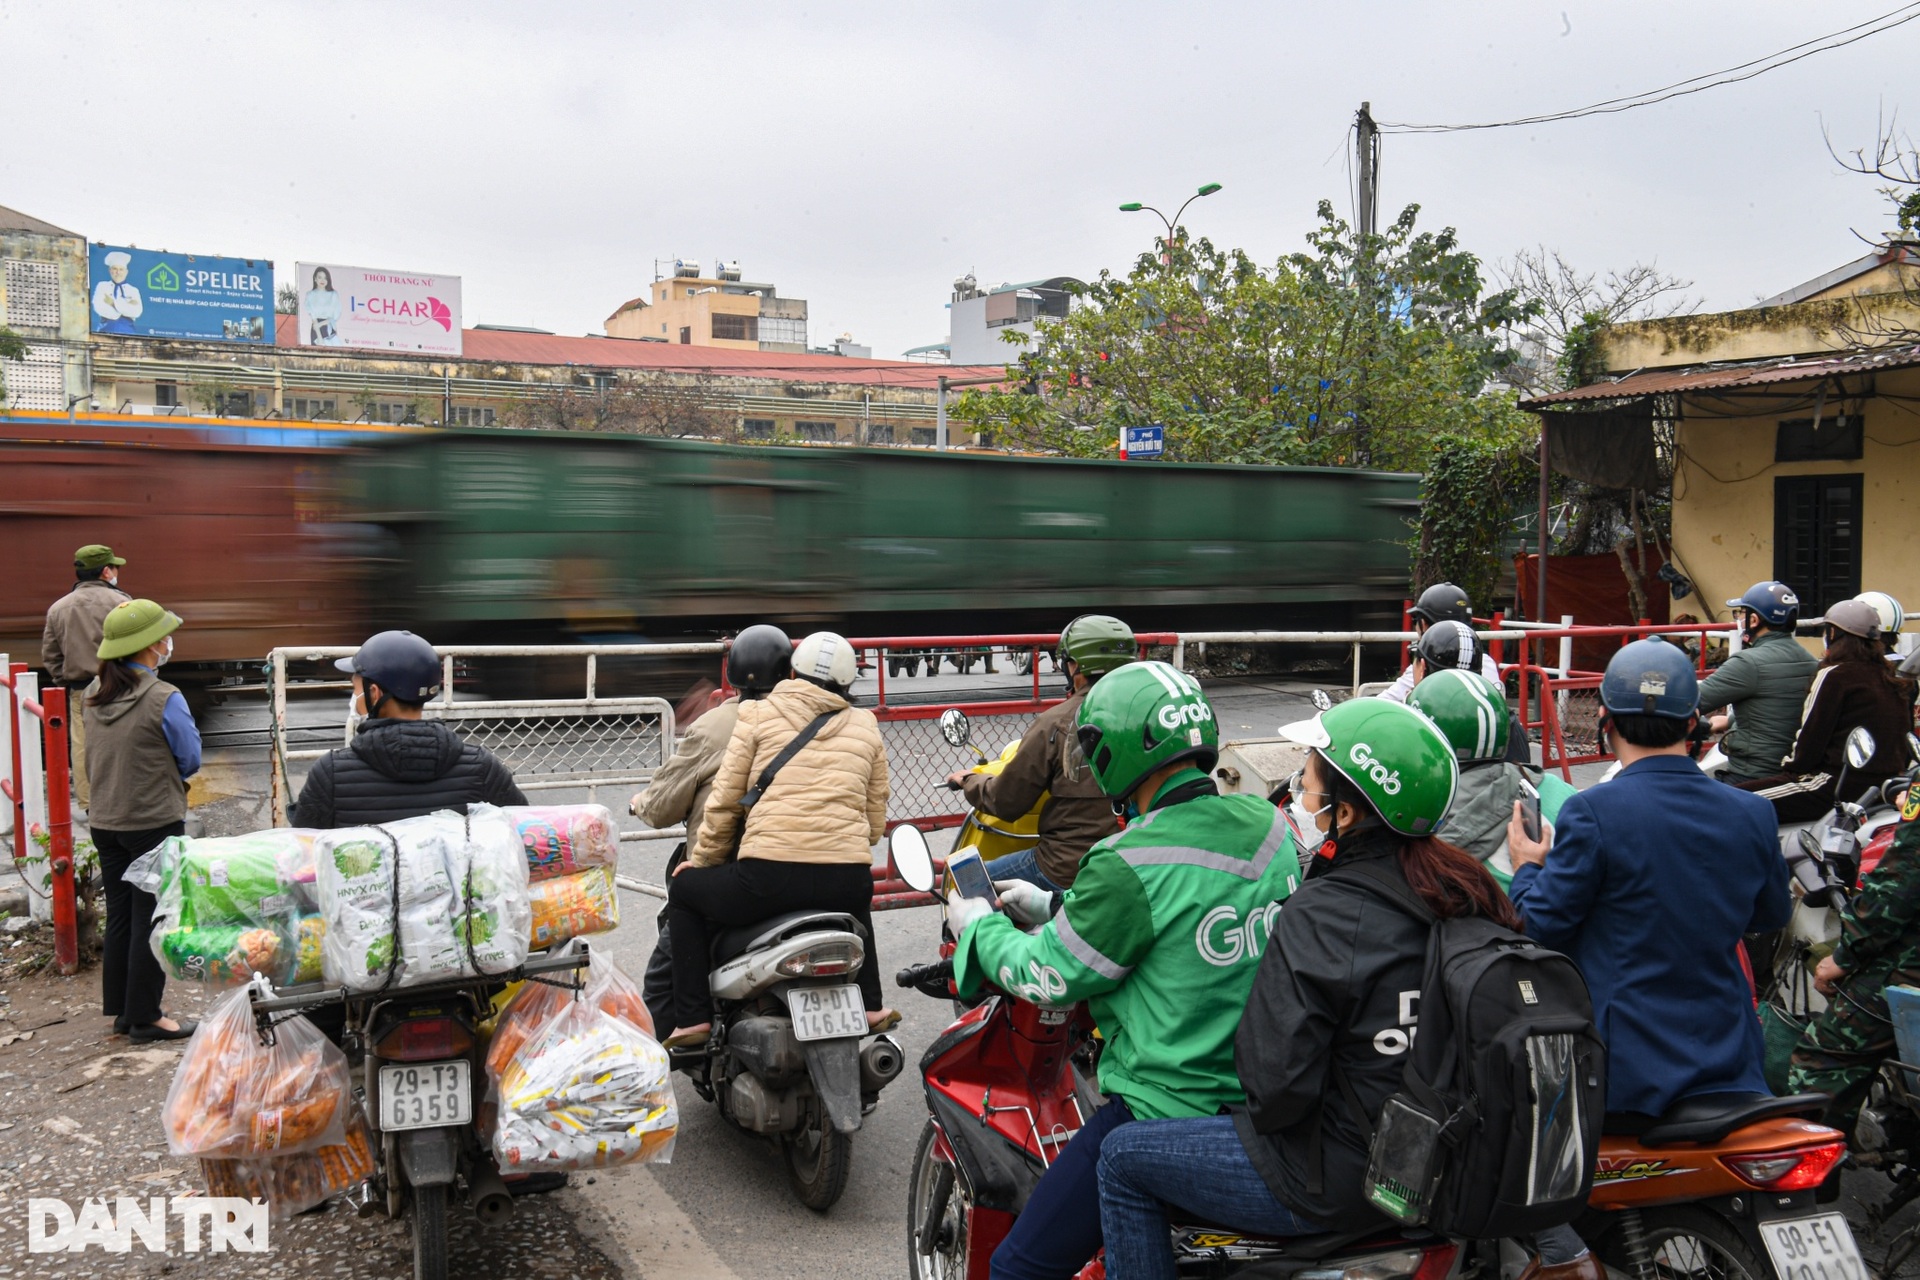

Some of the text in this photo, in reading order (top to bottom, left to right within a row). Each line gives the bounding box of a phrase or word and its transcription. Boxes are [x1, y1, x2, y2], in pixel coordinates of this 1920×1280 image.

[185, 269, 263, 292] SPELIER
[388, 275, 419, 286] TRANG
[1158, 696, 1212, 729] Grab
[1349, 741, 1402, 796] Grab
[799, 988, 852, 1013] 29-D1
[799, 1010, 863, 1037] 146.45
[392, 1065, 459, 1097] 29-T3
[393, 1093, 459, 1125] 6359
[1776, 1220, 1844, 1260] 98-E1
